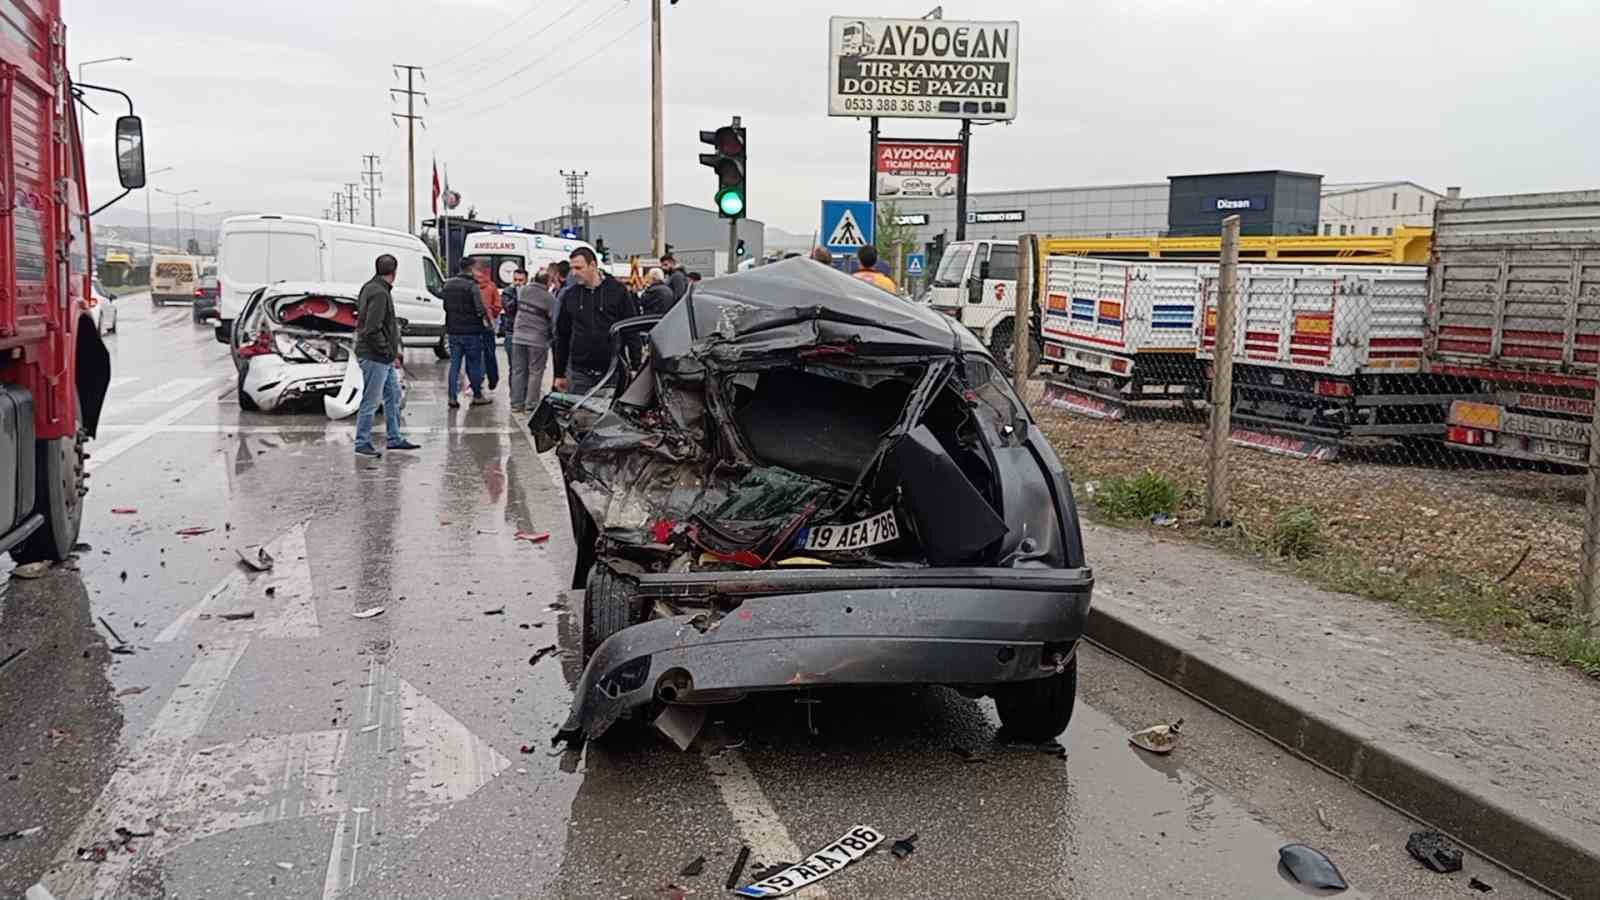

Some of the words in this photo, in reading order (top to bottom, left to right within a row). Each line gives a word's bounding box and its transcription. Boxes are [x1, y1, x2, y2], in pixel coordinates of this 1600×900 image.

[857, 61, 994, 80] TIR-KAMYON
[843, 78, 921, 95] DORSE
[927, 82, 1004, 97] PAZARI
[845, 99, 873, 111] 0533
[876, 100, 897, 112] 388
[900, 101, 915, 112] 36
[882, 147, 956, 161] AYDOĞAN
[1217, 199, 1250, 209] Dizsan
[475, 241, 516, 250] AMBULANS
[810, 526, 834, 548] 19
[836, 522, 869, 548] AEA
[872, 512, 897, 543] 786
[757, 875, 795, 893] 19
[789, 853, 842, 881] AEA
[826, 827, 878, 858] 786
